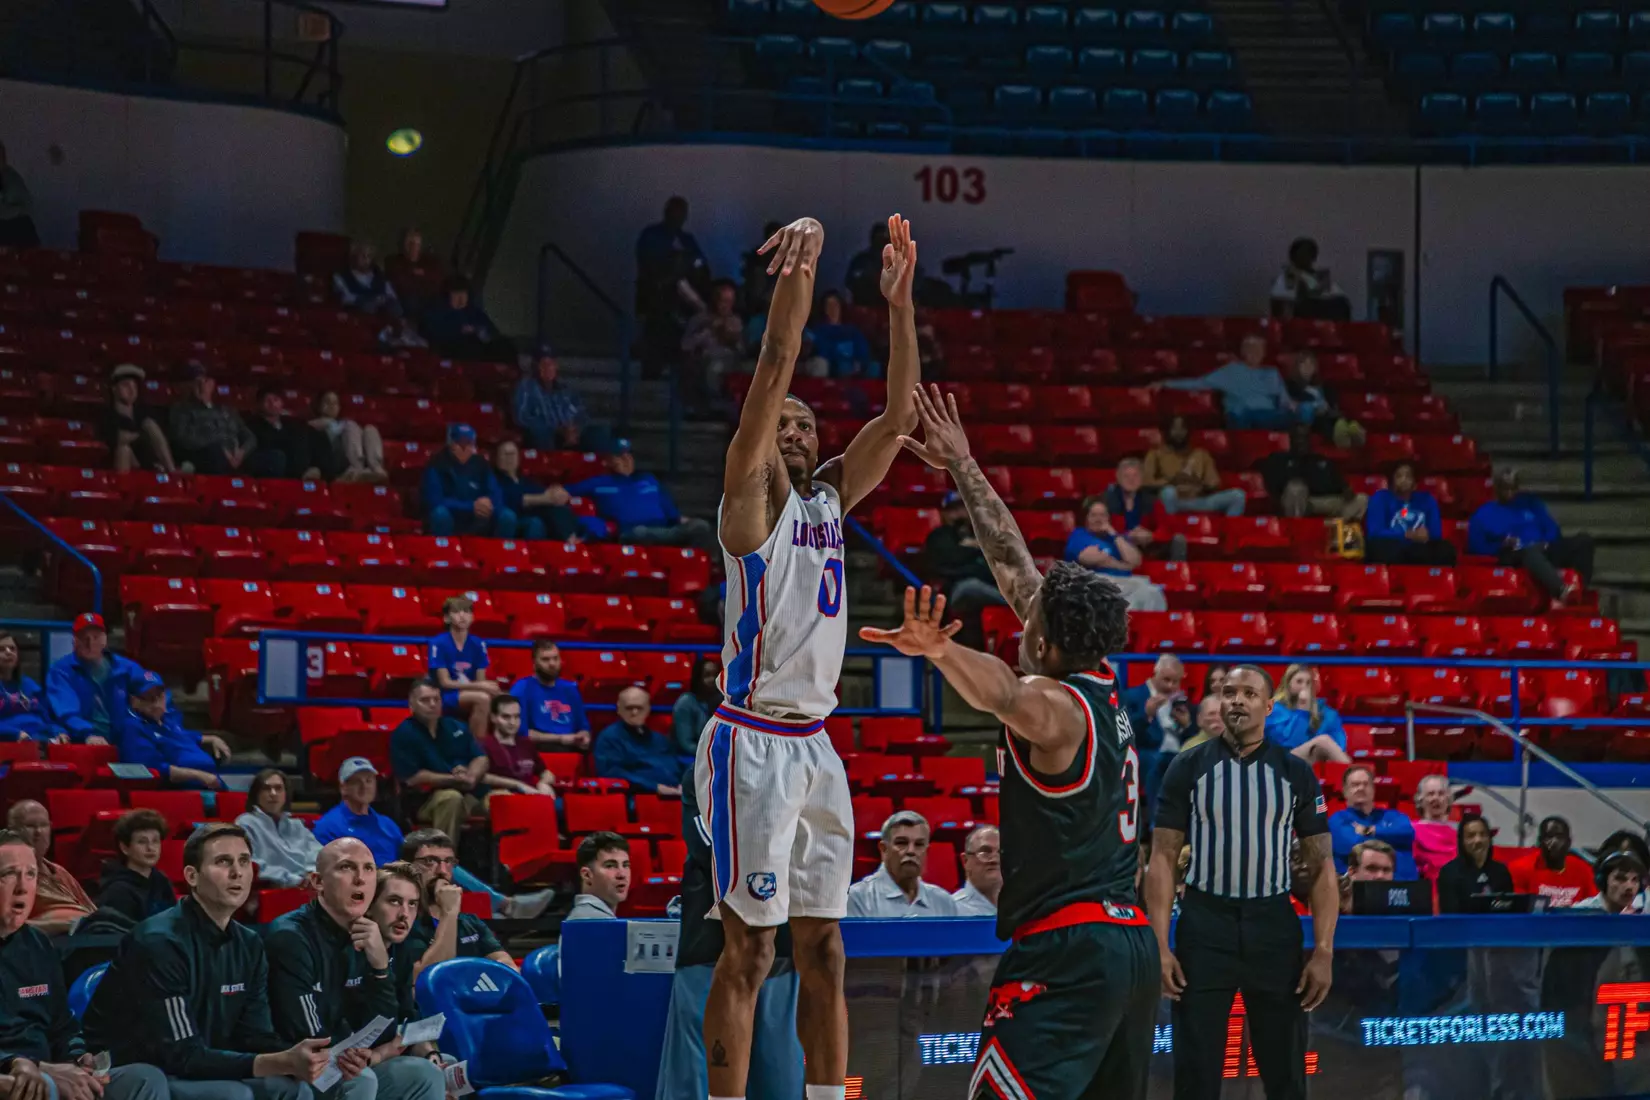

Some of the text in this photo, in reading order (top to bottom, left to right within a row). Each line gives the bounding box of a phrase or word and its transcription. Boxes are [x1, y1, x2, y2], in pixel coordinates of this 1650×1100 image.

[913, 165, 987, 205] 103
[818, 558, 843, 617] 0
[1118, 744, 1139, 844] 3
[1361, 1011, 1565, 1046] TICKETSFORLESS.COM
